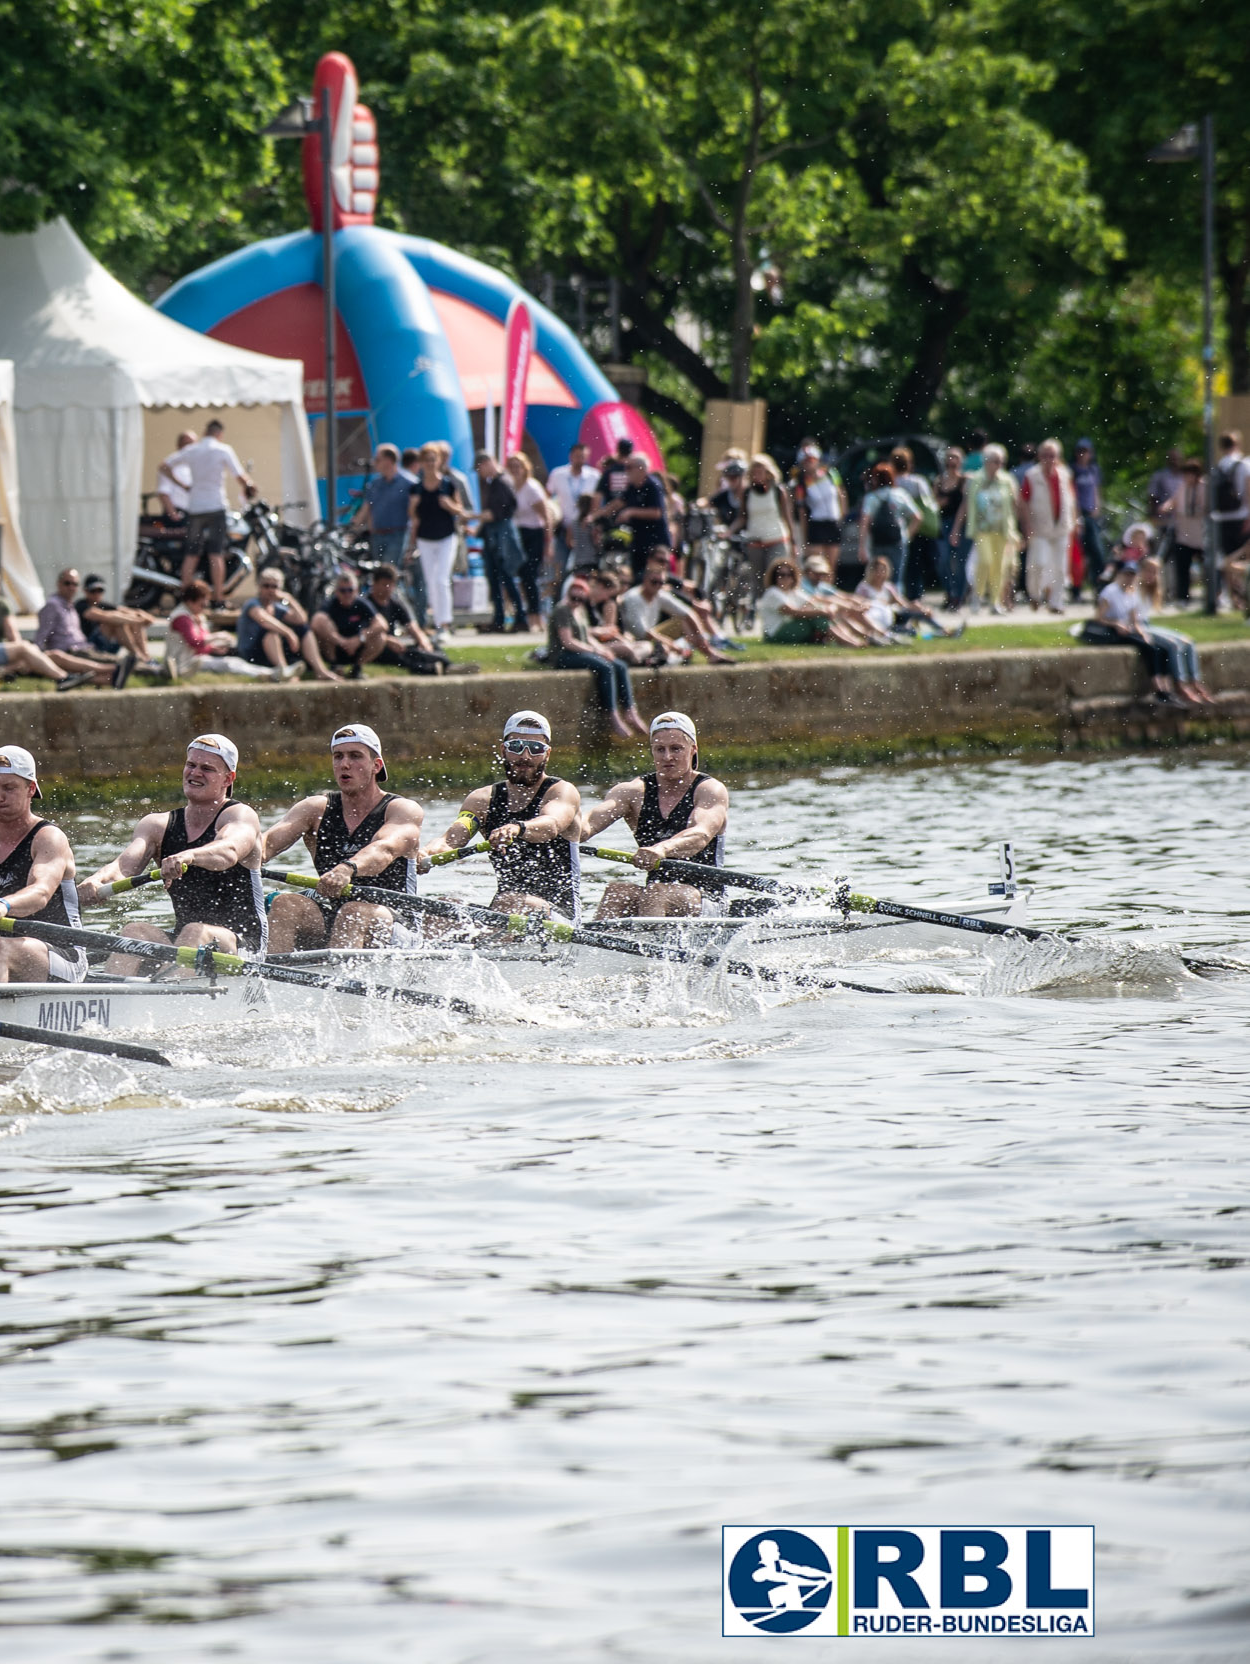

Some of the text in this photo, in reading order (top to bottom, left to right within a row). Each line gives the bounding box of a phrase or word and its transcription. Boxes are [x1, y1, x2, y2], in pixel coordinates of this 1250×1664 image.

[1004, 843, 1012, 881] 5
[904, 908, 939, 921] SCHNELL.
[962, 918, 982, 928] RBL
[38, 998, 110, 1032] MINDEN
